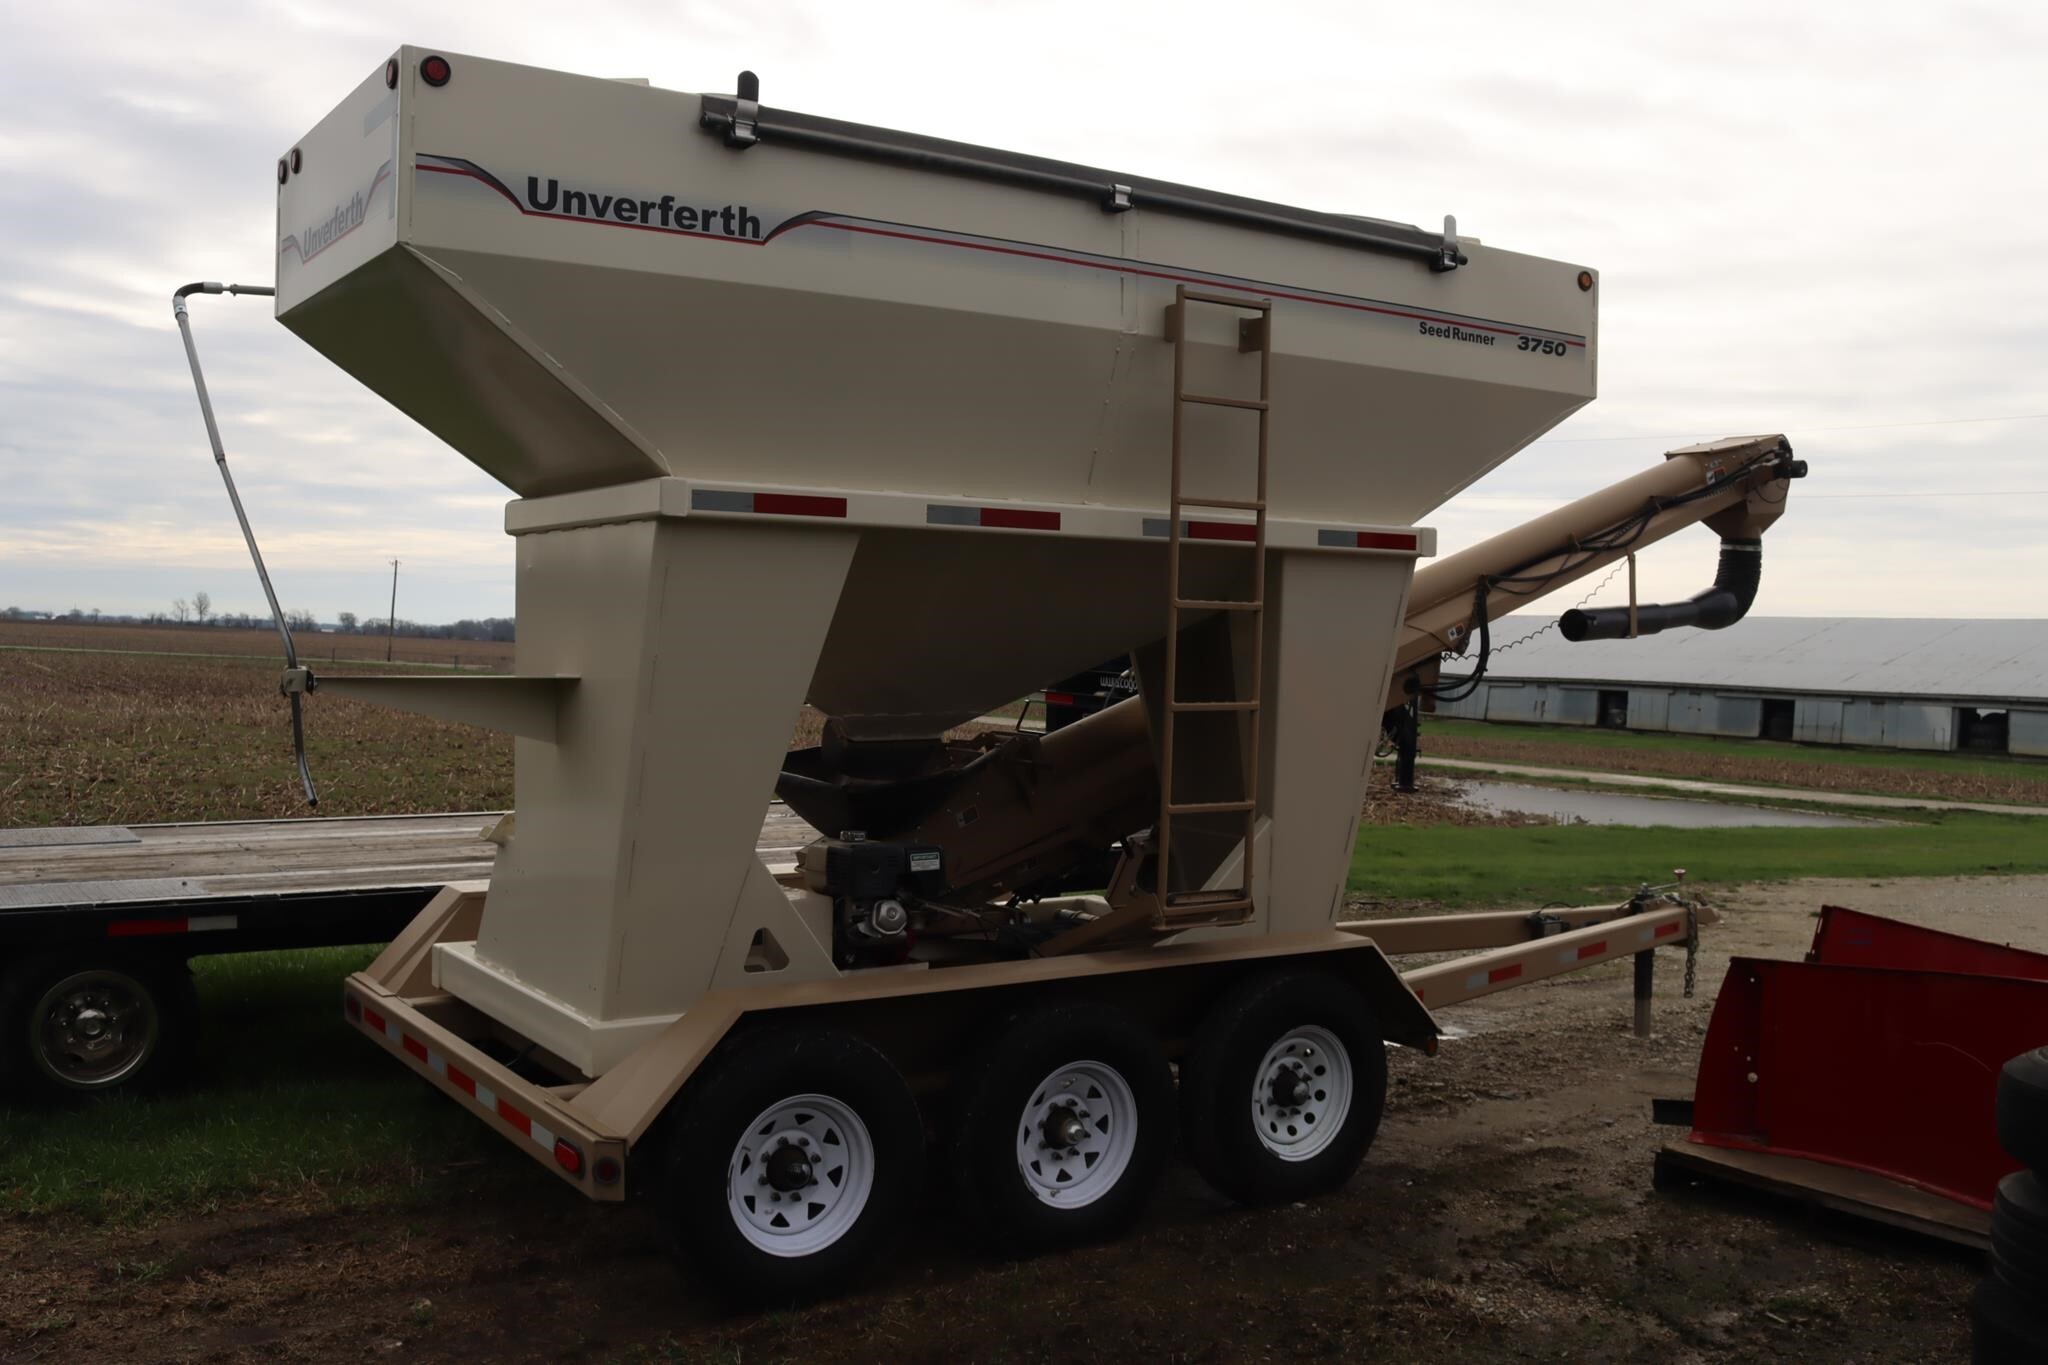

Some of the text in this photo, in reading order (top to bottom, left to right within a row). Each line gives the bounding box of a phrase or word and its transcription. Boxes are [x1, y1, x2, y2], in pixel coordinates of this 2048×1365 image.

[303, 191, 363, 258] Unverferth
[527, 176, 762, 239] Unverferth
[1517, 335, 1567, 357] 3750
